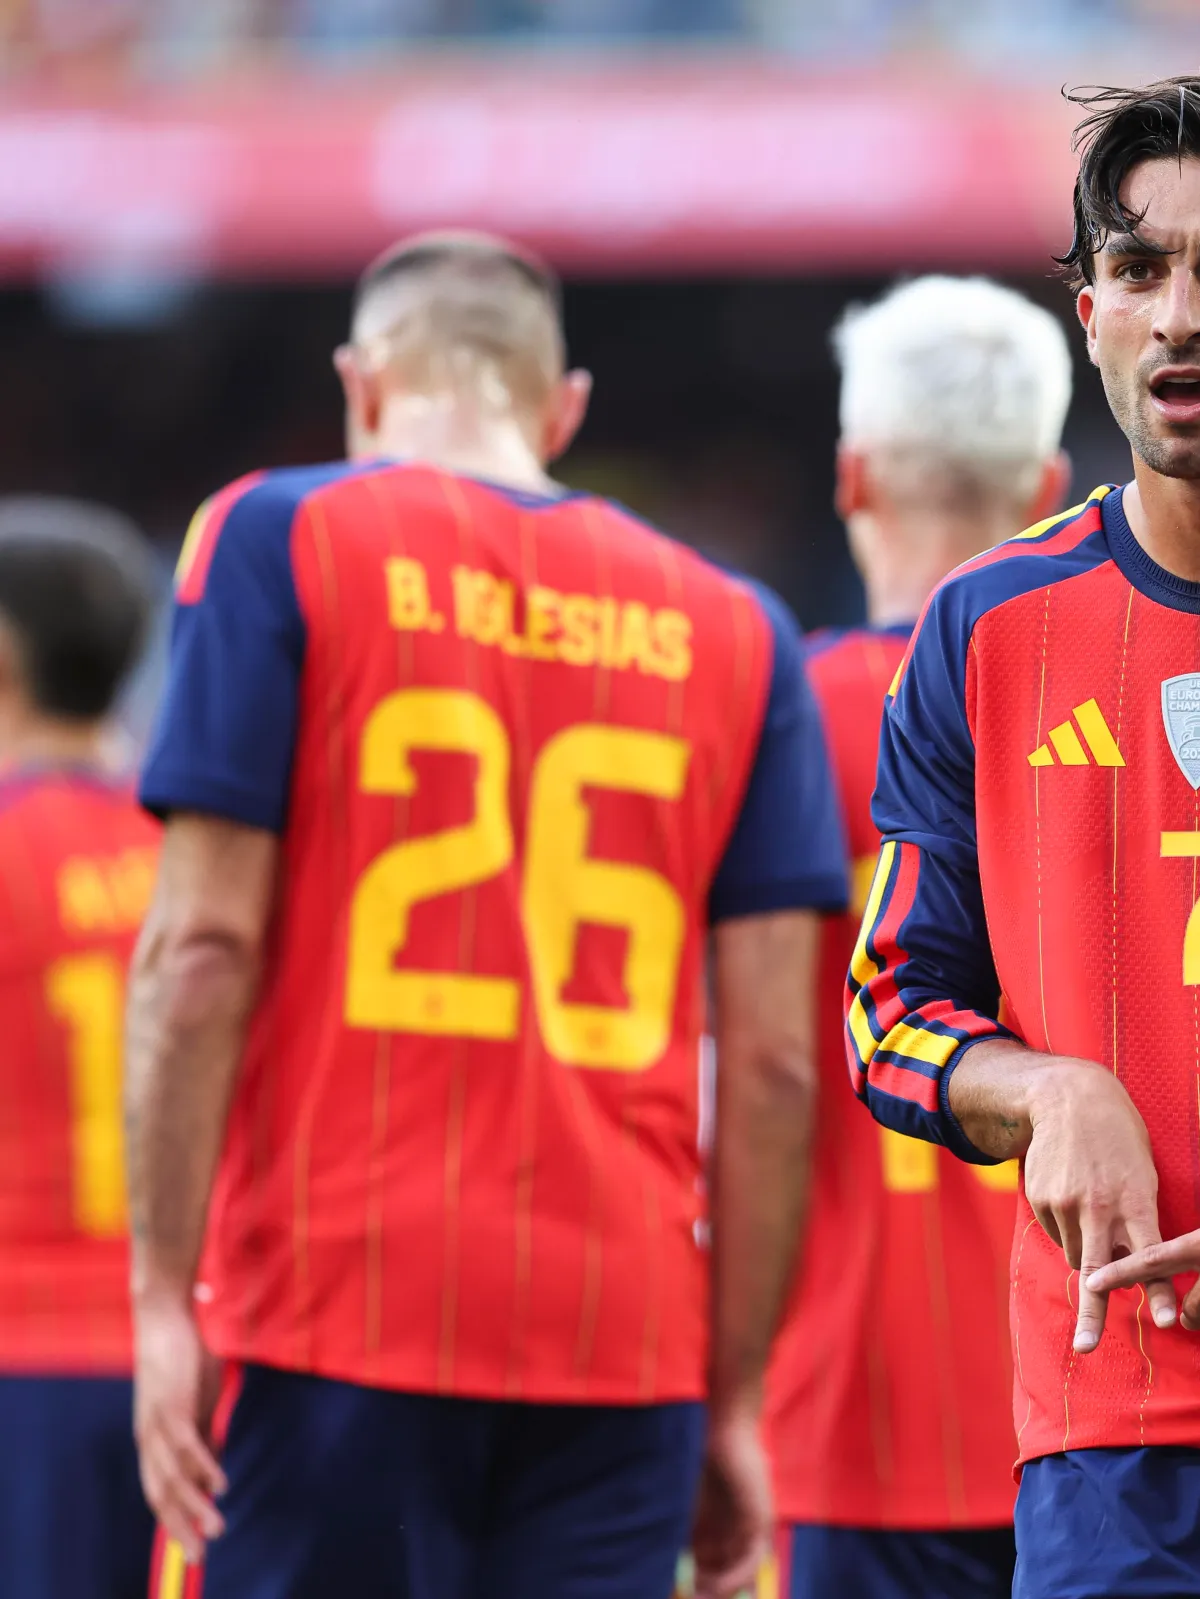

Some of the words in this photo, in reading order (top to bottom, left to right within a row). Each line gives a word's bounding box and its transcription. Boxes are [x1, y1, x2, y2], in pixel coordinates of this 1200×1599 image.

[386, 556, 445, 634] B.
[453, 564, 693, 681] IGLESIAS
[345, 687, 690, 1072] 26
